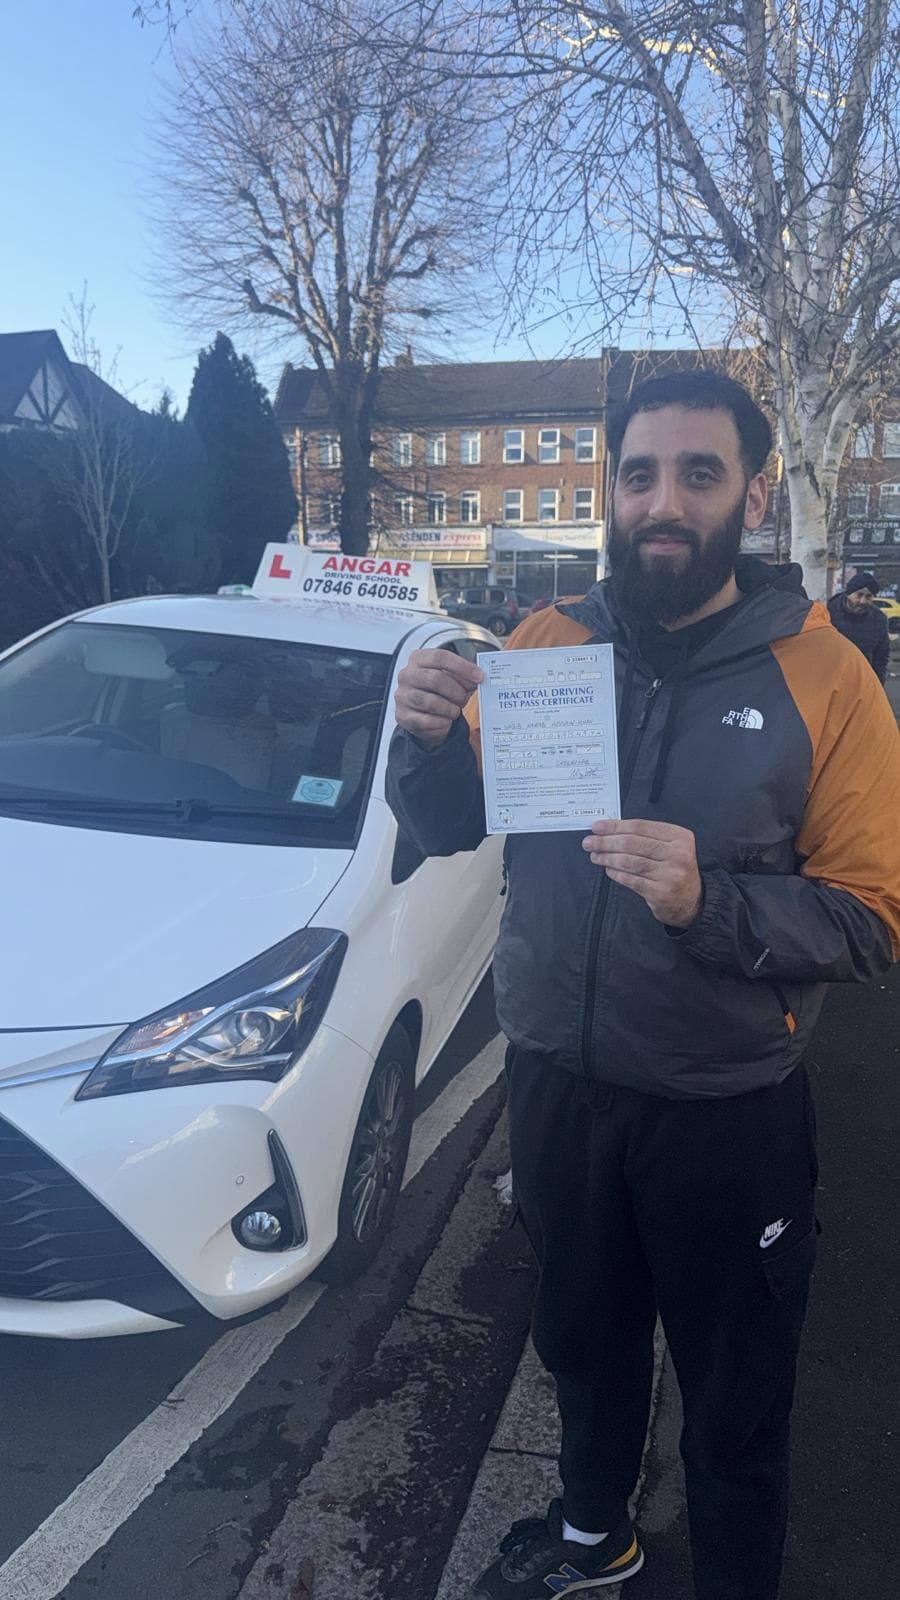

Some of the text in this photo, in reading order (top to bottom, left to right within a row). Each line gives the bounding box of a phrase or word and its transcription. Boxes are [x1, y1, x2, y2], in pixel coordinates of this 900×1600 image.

[269, 554, 292, 579] L
[322, 556, 412, 577] ANGAR
[324, 572, 402, 584] DRIVING SCHOOL
[303, 578, 419, 602] 07846 640585
[498, 686, 594, 700] PRACTICAL DRIVING
[499, 695, 594, 709] TEST PASS CERTIFICATE
[764, 1218, 784, 1239] NIKE
